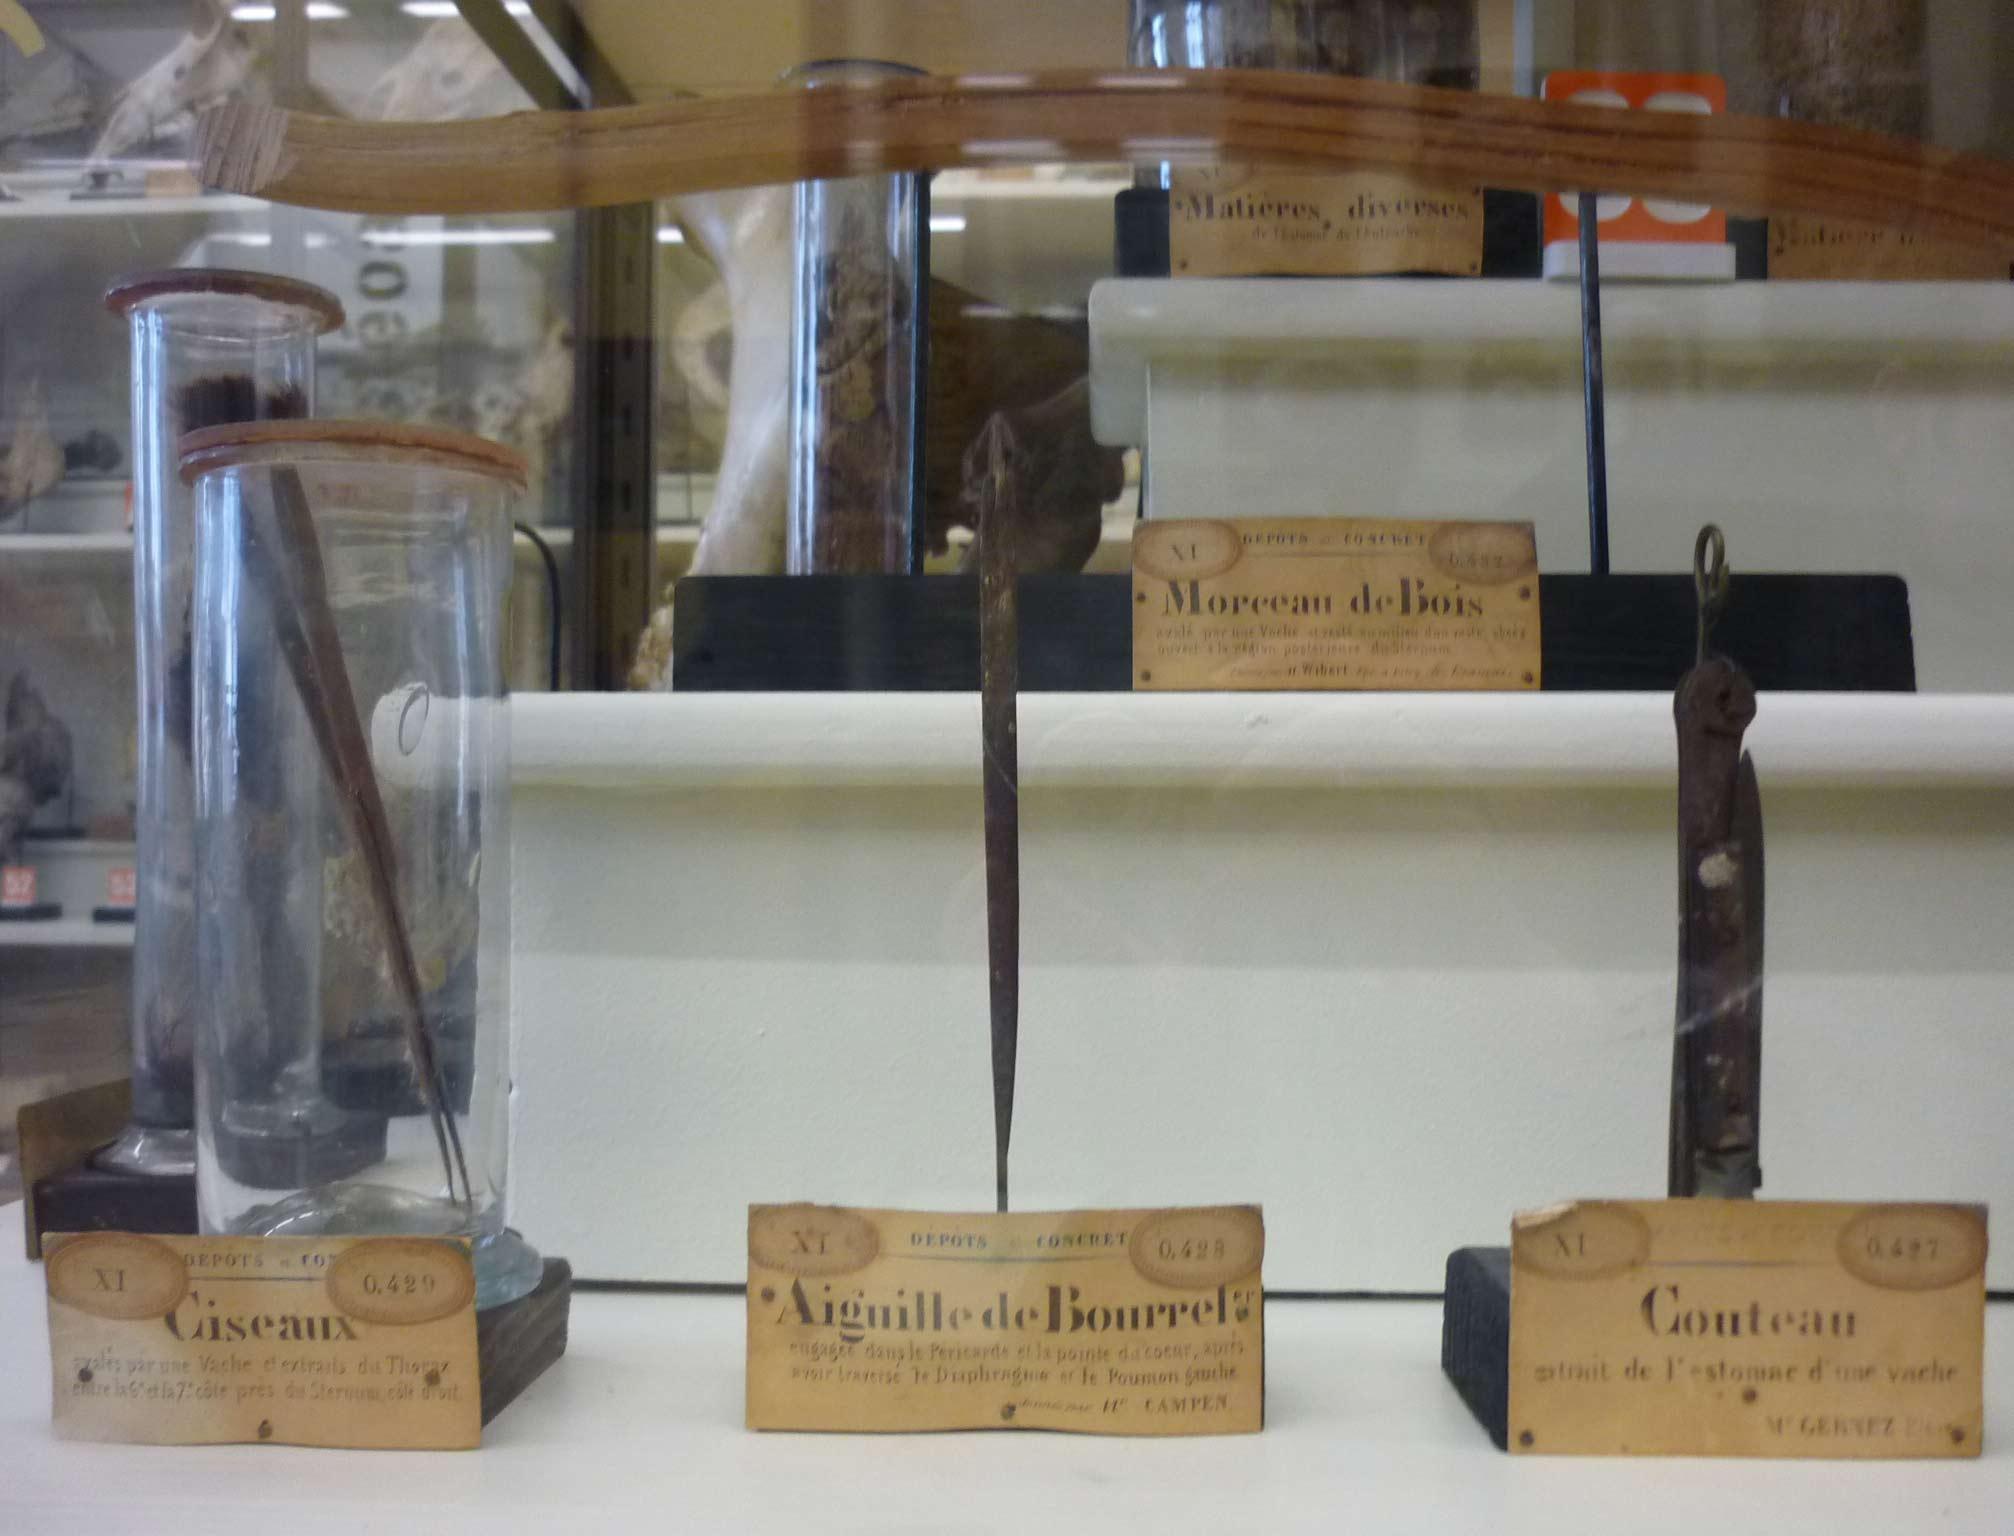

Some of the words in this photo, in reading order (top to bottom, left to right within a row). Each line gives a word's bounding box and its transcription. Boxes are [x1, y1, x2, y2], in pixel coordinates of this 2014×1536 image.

[1348, 190, 1470, 221] diverses
[1160, 577, 1333, 618] Morceau
[1349, 581, 1393, 618] de
[1398, 575, 1484, 619] Bois
[791, 1230, 832, 1257] XI
[1554, 1232, 1585, 1259] XI
[94, 1267, 127, 1293] XI
[361, 1272, 437, 1296] 0.429
[163, 1288, 360, 1343] Ciseaux
[776, 1277, 974, 1344] Aiguille
[981, 1290, 1040, 1333] de
[1640, 1283, 1857, 1338] Couteau
[1886, 1355, 1959, 1384] vache
